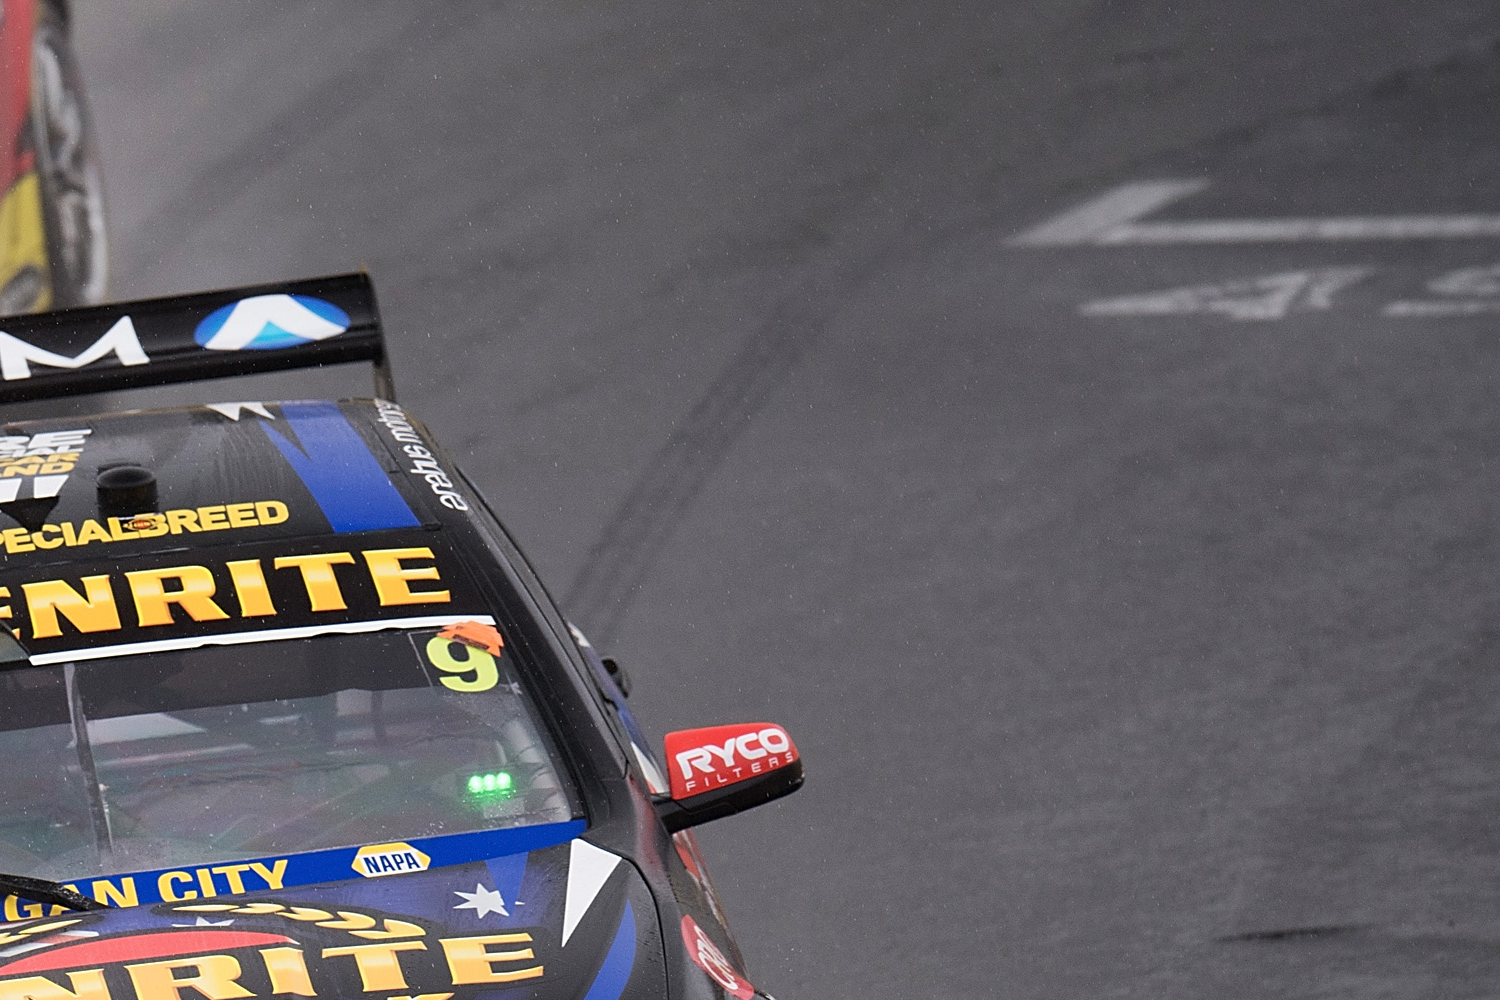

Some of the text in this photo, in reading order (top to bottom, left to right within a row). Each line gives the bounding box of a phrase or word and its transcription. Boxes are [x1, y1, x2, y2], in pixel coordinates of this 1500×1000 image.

[425, 634, 499, 692] 9
[675, 728, 789, 780] RYCO
[685, 751, 793, 792] FILTERS
[157, 859, 288, 903] CITY
[362, 851, 422, 877] NAPA
